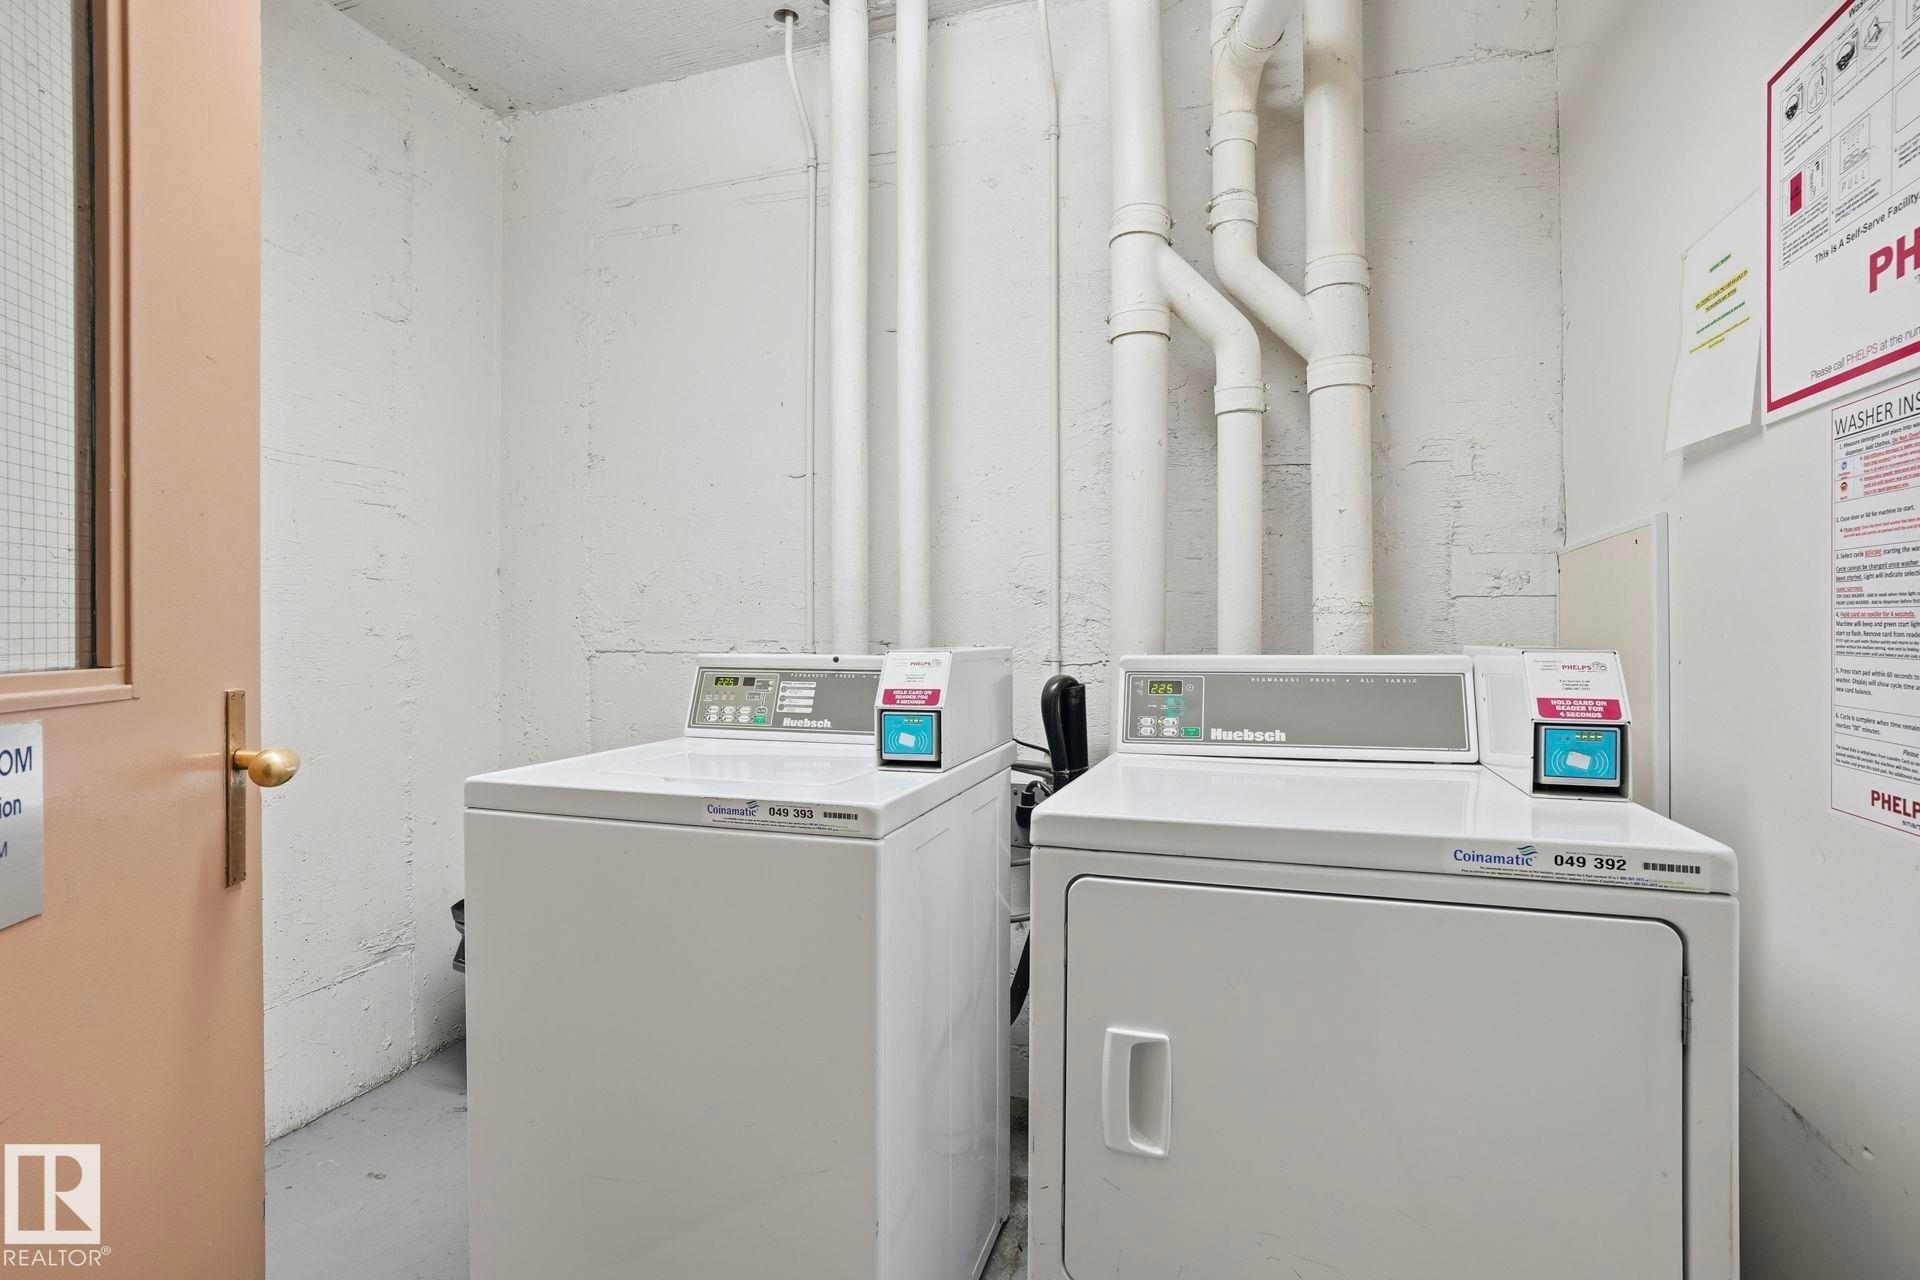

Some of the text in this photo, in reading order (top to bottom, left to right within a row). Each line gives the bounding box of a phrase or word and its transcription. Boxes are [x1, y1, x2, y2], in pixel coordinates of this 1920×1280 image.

[1814, 250, 1829, 263] This
[1831, 245, 1837, 254] Is
[1839, 239, 1844, 249] A
[1846, 214, 1885, 244] Self-Serve
[1811, 365, 1831, 380] Please
[1834, 358, 1845, 371] call
[1847, 343, 1878, 365] PHELPS
[1880, 340, 1888, 351] at
[1890, 335, 1903, 346] the
[1834, 402, 1893, 435] WASHER
[718, 678, 735, 686] 225
[1151, 684, 1173, 694] 225
[783, 718, 831, 729] Huebsch
[1210, 728, 1286, 742] Huebsch
[707, 804, 814, 819] Coinamatic 049 393
[1454, 849, 1533, 866] Coinamatic
[1554, 855, 1586, 867] 049
[1594, 857, 1627, 871] 392
